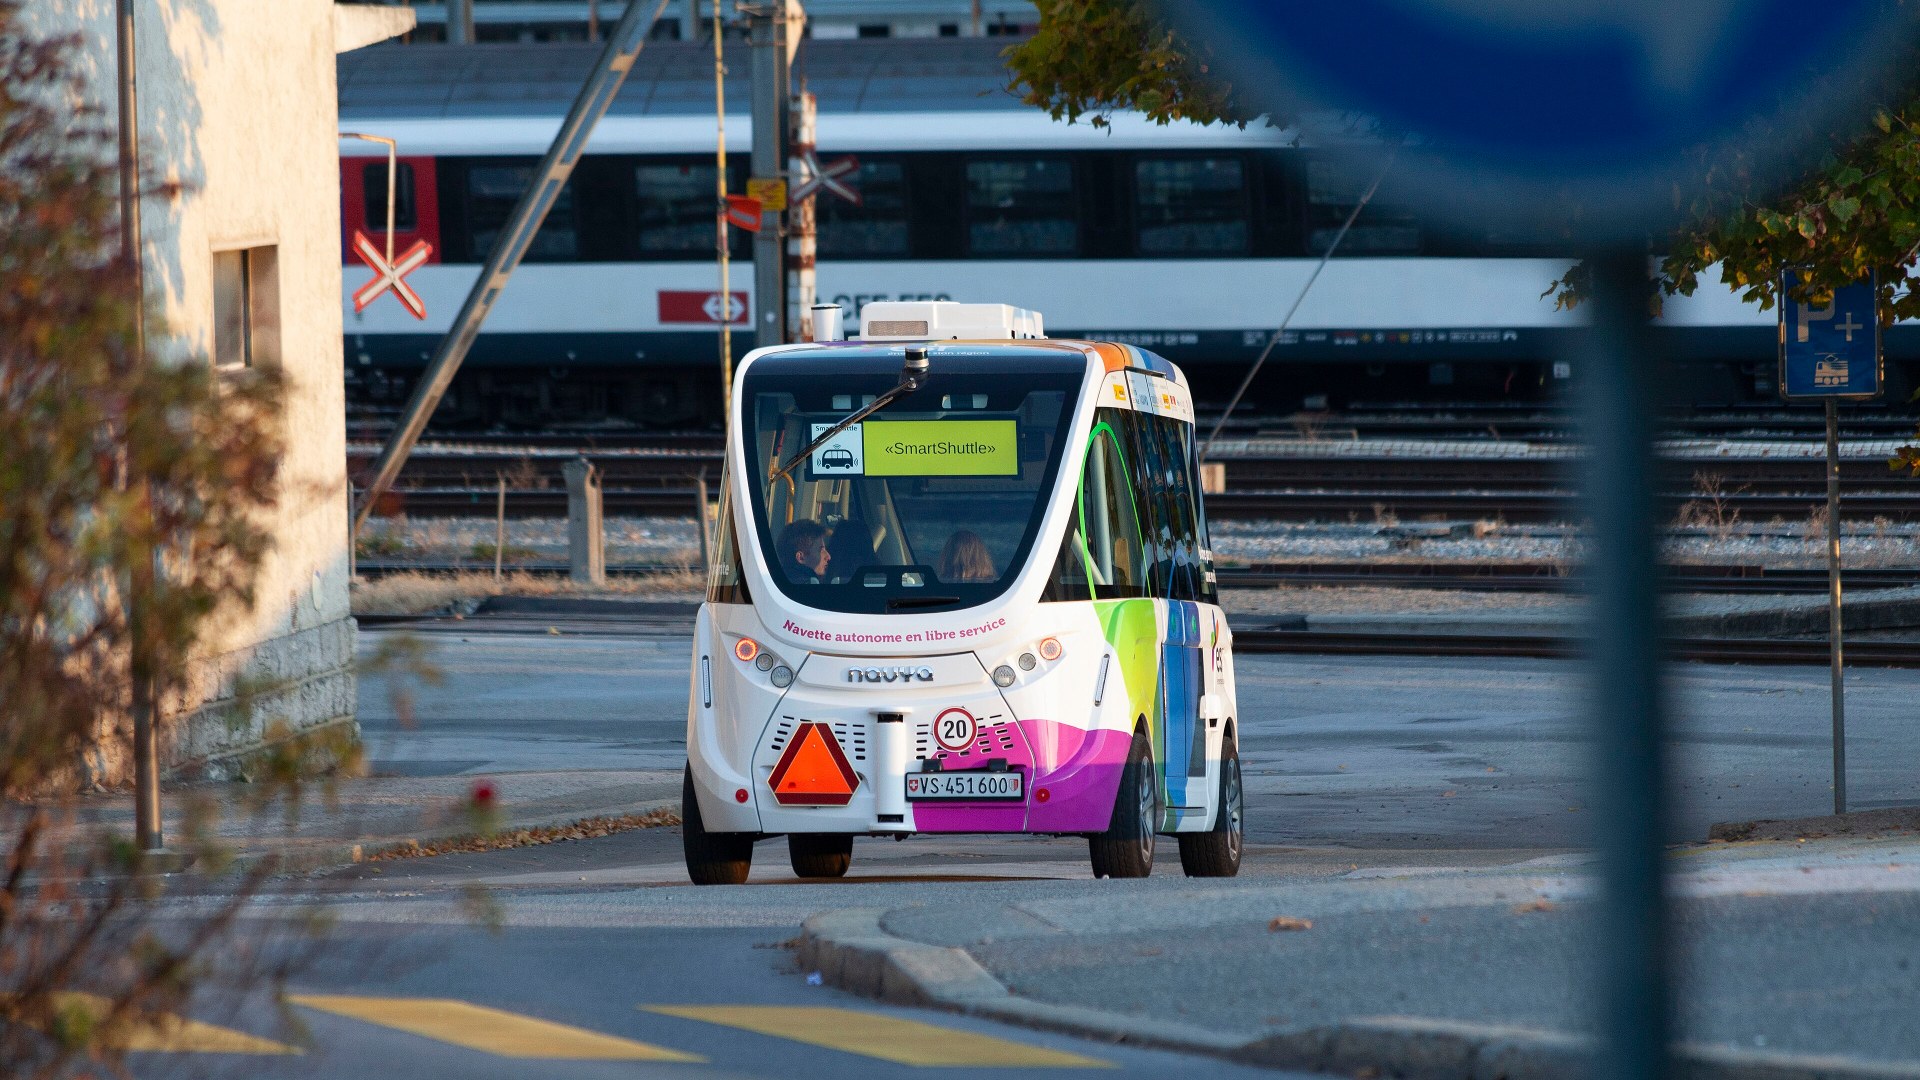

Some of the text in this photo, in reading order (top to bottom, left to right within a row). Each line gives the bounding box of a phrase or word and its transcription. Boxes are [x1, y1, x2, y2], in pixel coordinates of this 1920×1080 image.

[782, 617, 1007, 643] Navette autonome en libre service
[943, 719, 967, 739] 20
